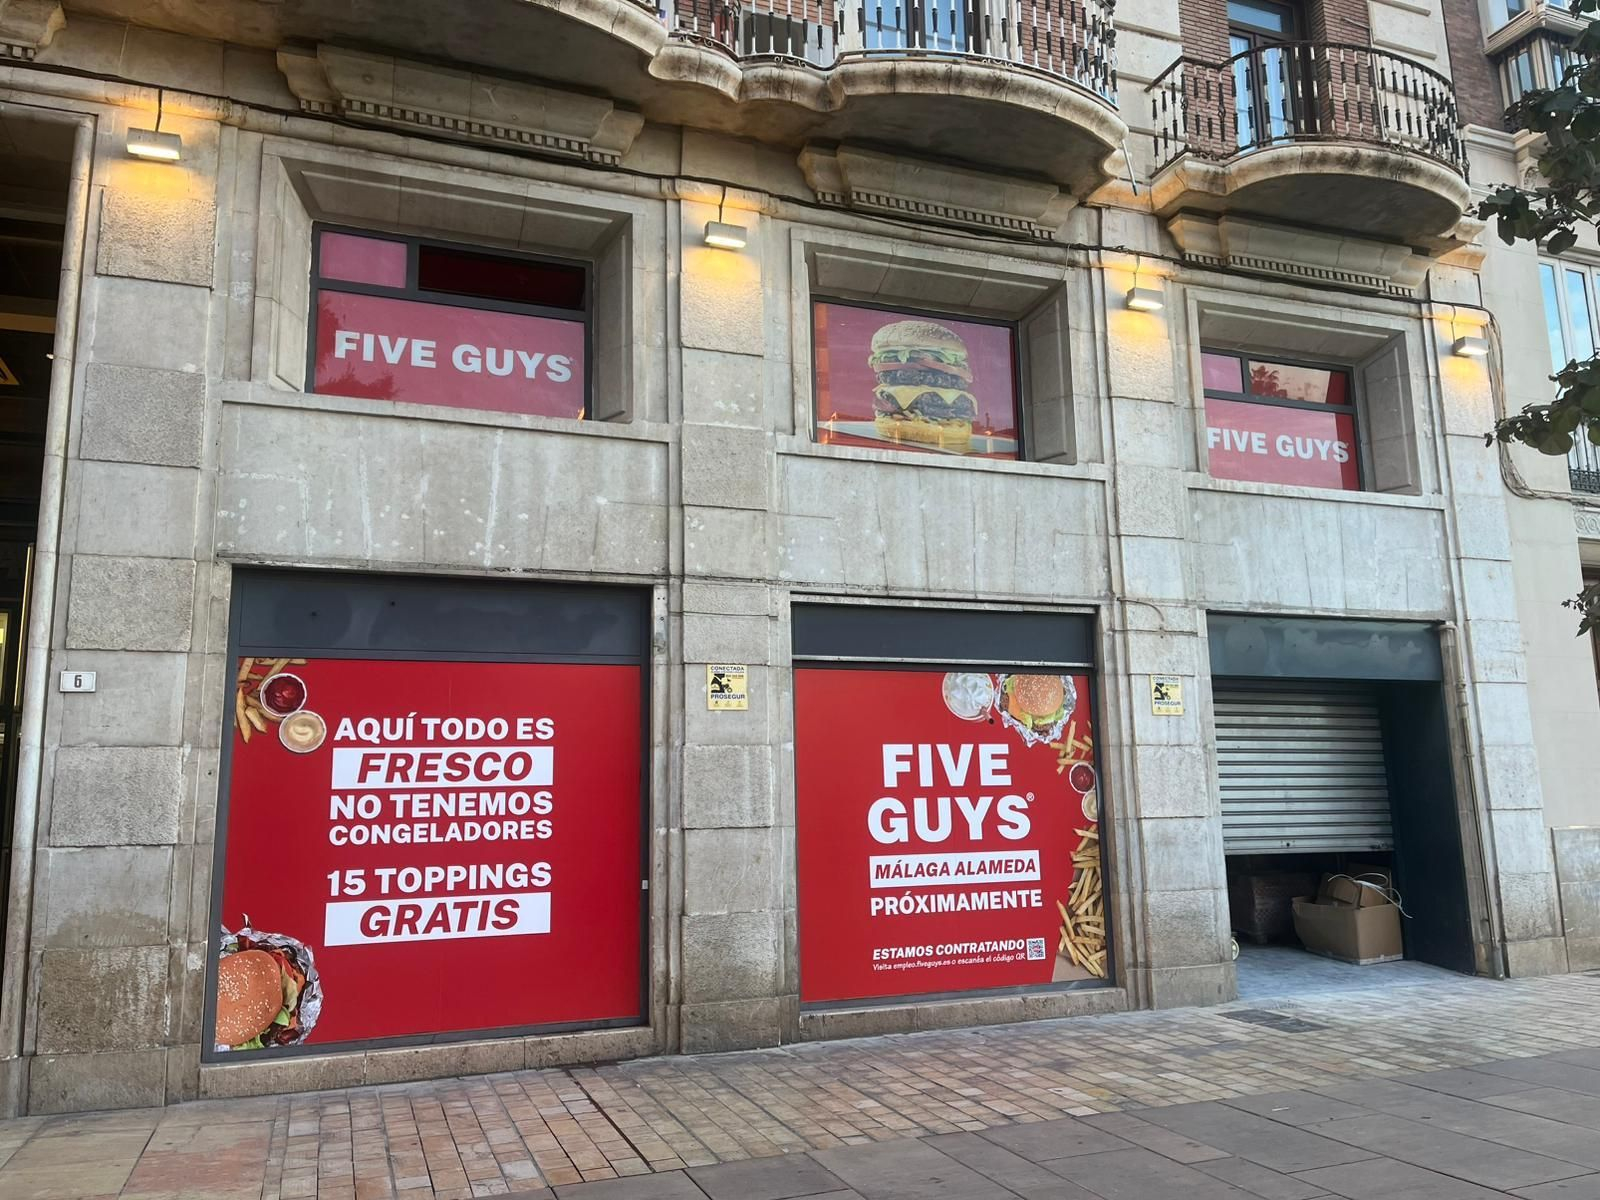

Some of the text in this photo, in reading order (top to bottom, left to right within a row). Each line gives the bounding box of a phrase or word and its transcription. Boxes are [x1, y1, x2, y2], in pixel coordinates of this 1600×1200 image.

[335, 330, 573, 382] FIVE GUYS
[1206, 427, 1349, 463] FIVE GUYS
[74, 675, 82, 688] 6
[334, 712, 554, 744] AQUÍ TODO ES
[357, 751, 533, 783] FRESCO
[882, 743, 1012, 787] FIVE
[329, 791, 553, 820] NO TENEMOS
[328, 820, 553, 846] CONGELADORES
[327, 862, 552, 896] 15 TOPPINGS
[875, 858, 1036, 880] MÁLAGA ALAMEDA
[870, 889, 1043, 916] PRÓXIMAMENTE
[359, 899, 520, 937] GRATIS
[872, 939, 1025, 961] ESTAMOS CONTRATANDO
[872, 963, 892, 971] Visita
[985, 955, 992, 963] el
[992, 954, 1014, 962] código
[1015, 952, 1026, 960] QR
